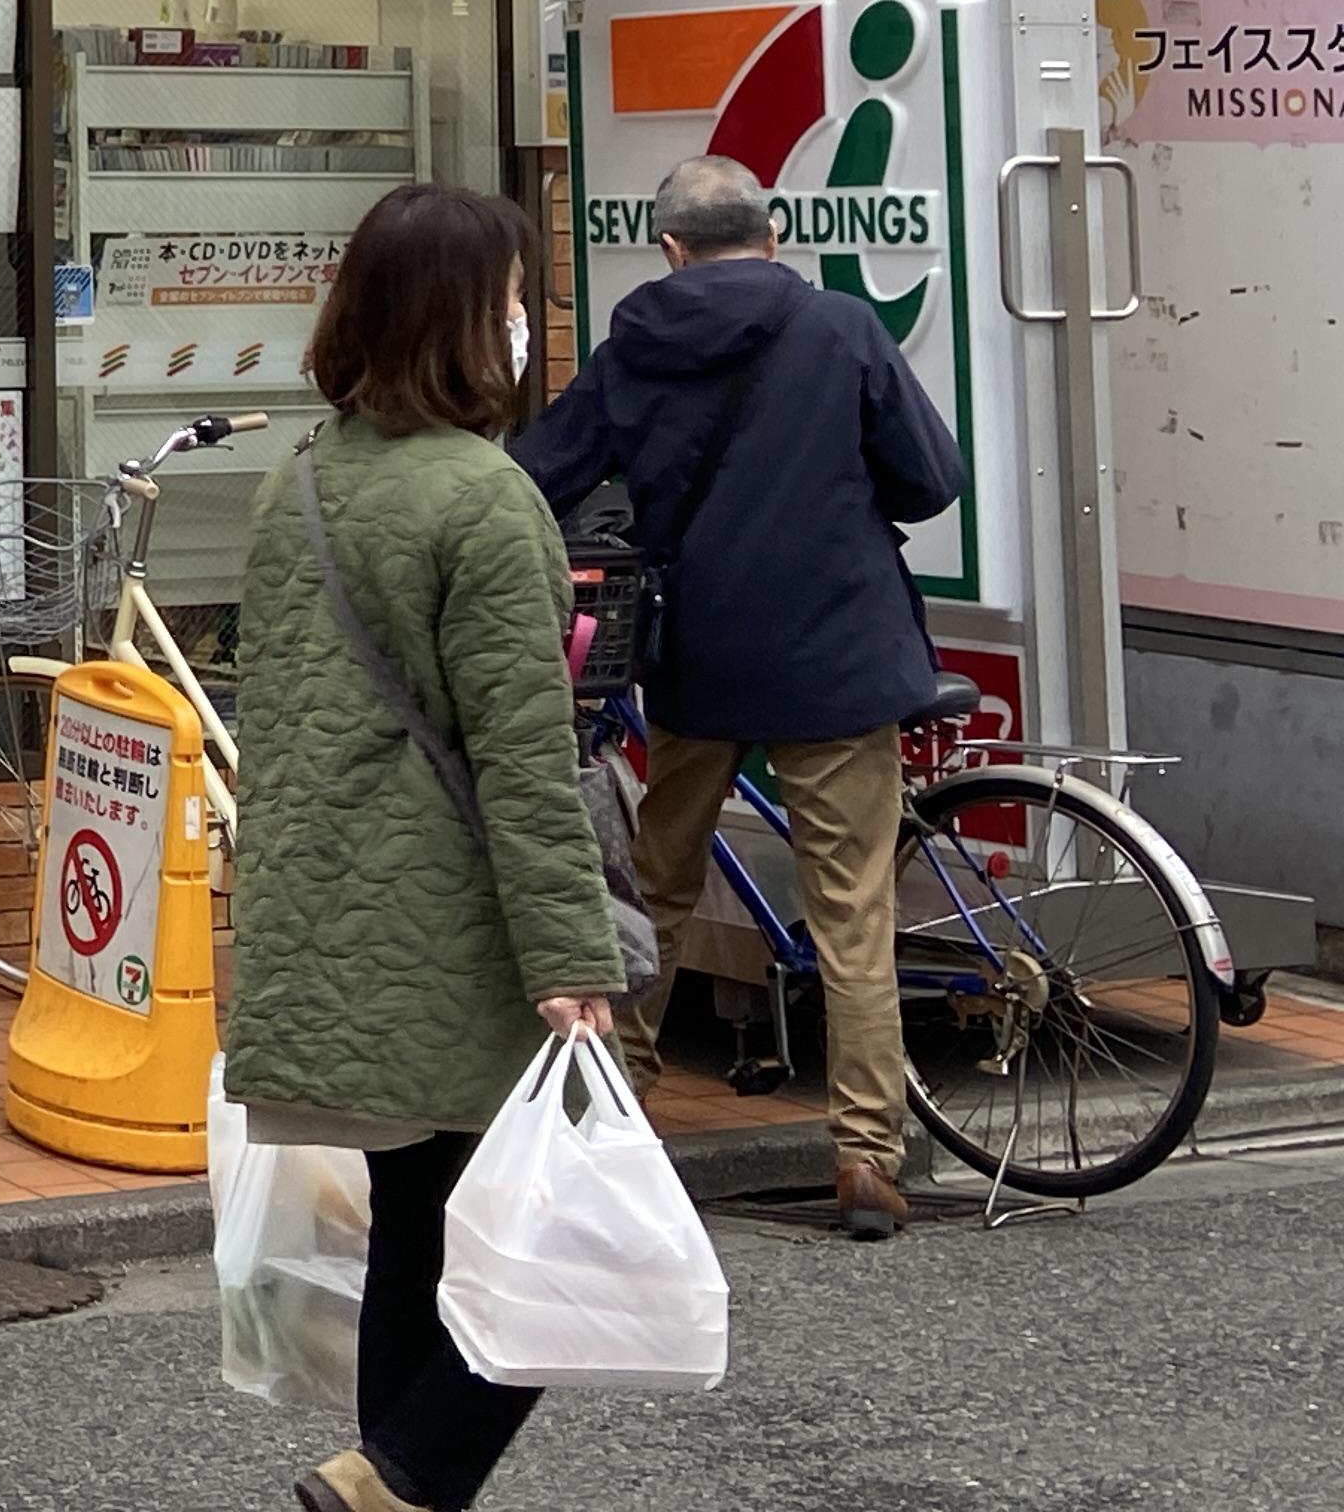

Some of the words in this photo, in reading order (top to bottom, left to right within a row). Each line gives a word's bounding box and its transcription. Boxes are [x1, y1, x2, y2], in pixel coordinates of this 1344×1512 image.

[1187, 87, 1344, 119] MISSION
[588, 195, 662, 245] SEVE
[768, 192, 929, 245] OLDINGS
